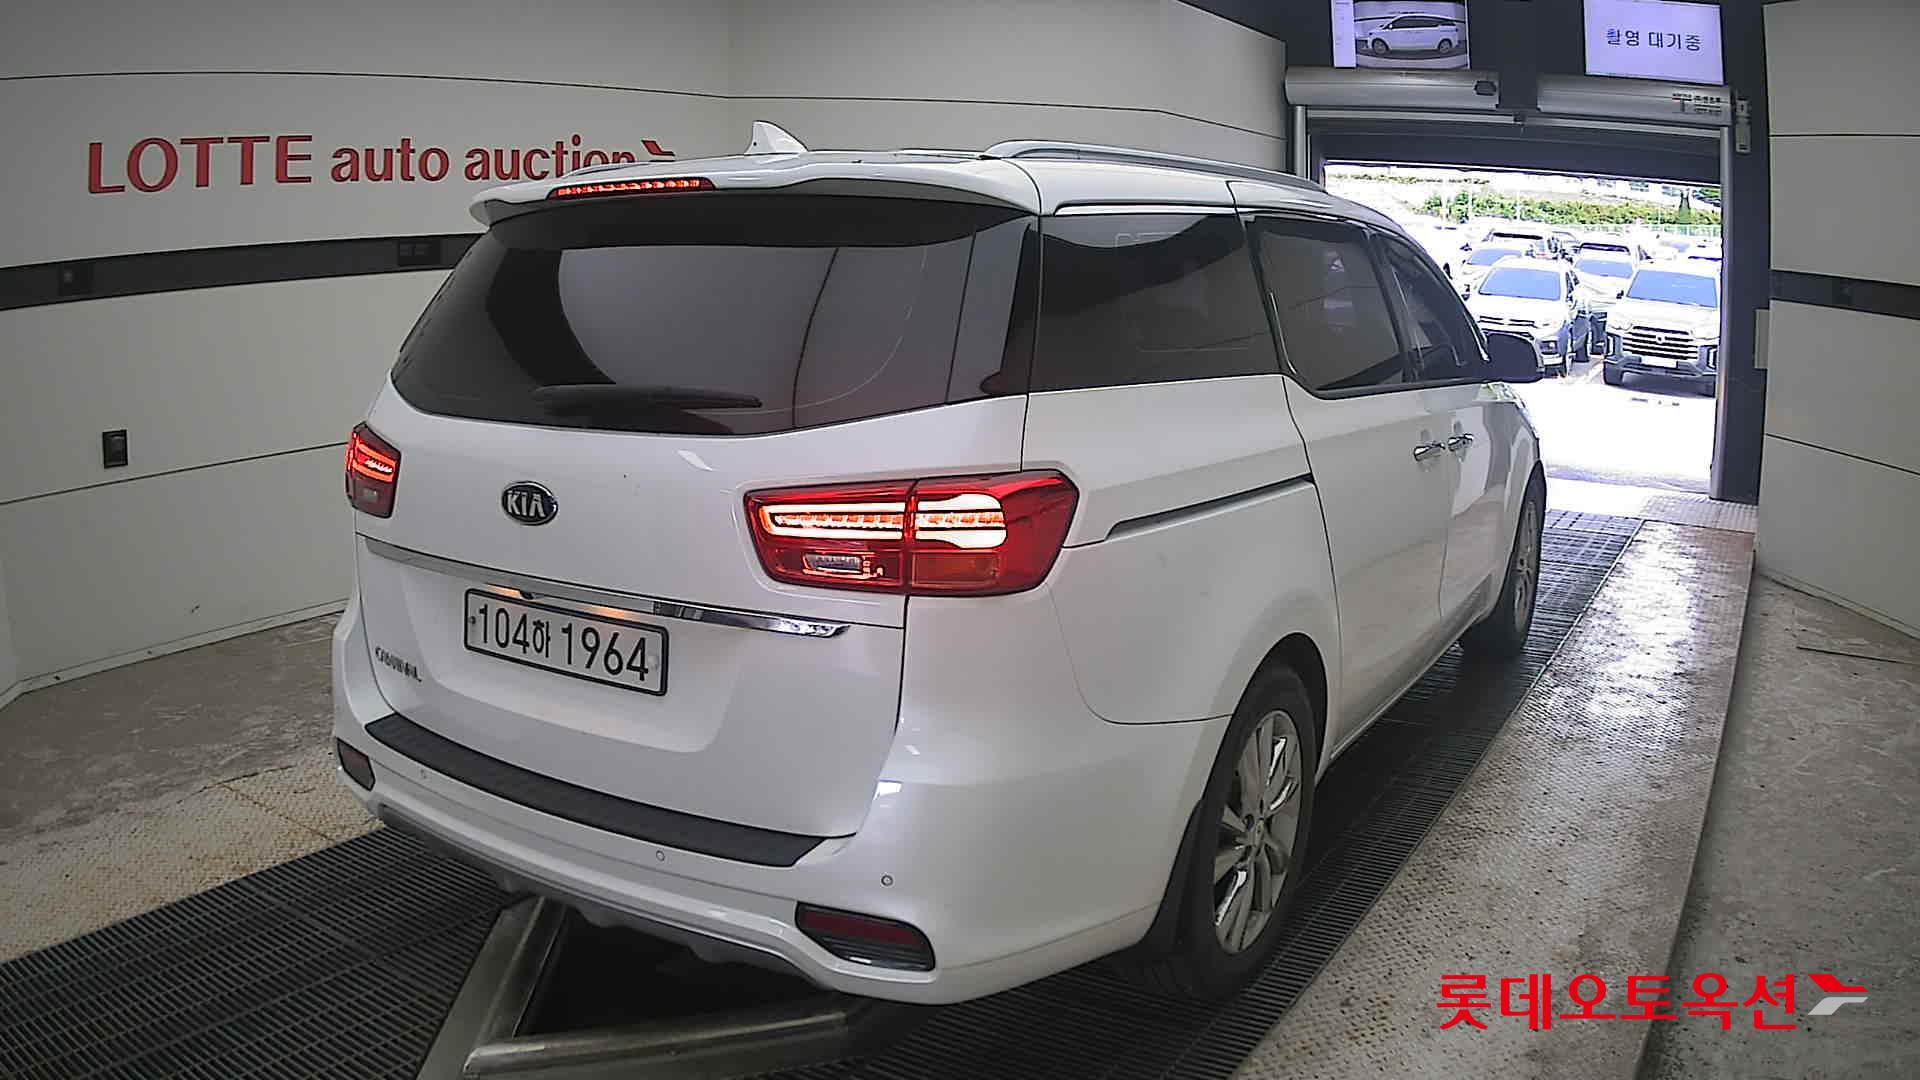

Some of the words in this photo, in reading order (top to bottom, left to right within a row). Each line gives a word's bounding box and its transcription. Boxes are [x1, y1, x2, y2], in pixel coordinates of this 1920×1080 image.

[1648, 31, 1702, 52] 대기중
[88, 135, 312, 194] LOTTE
[331, 138, 449, 184] auto
[507, 489, 546, 518] KIA
[478, 603, 551, 659] 104하
[561, 622, 649, 682] 1964
